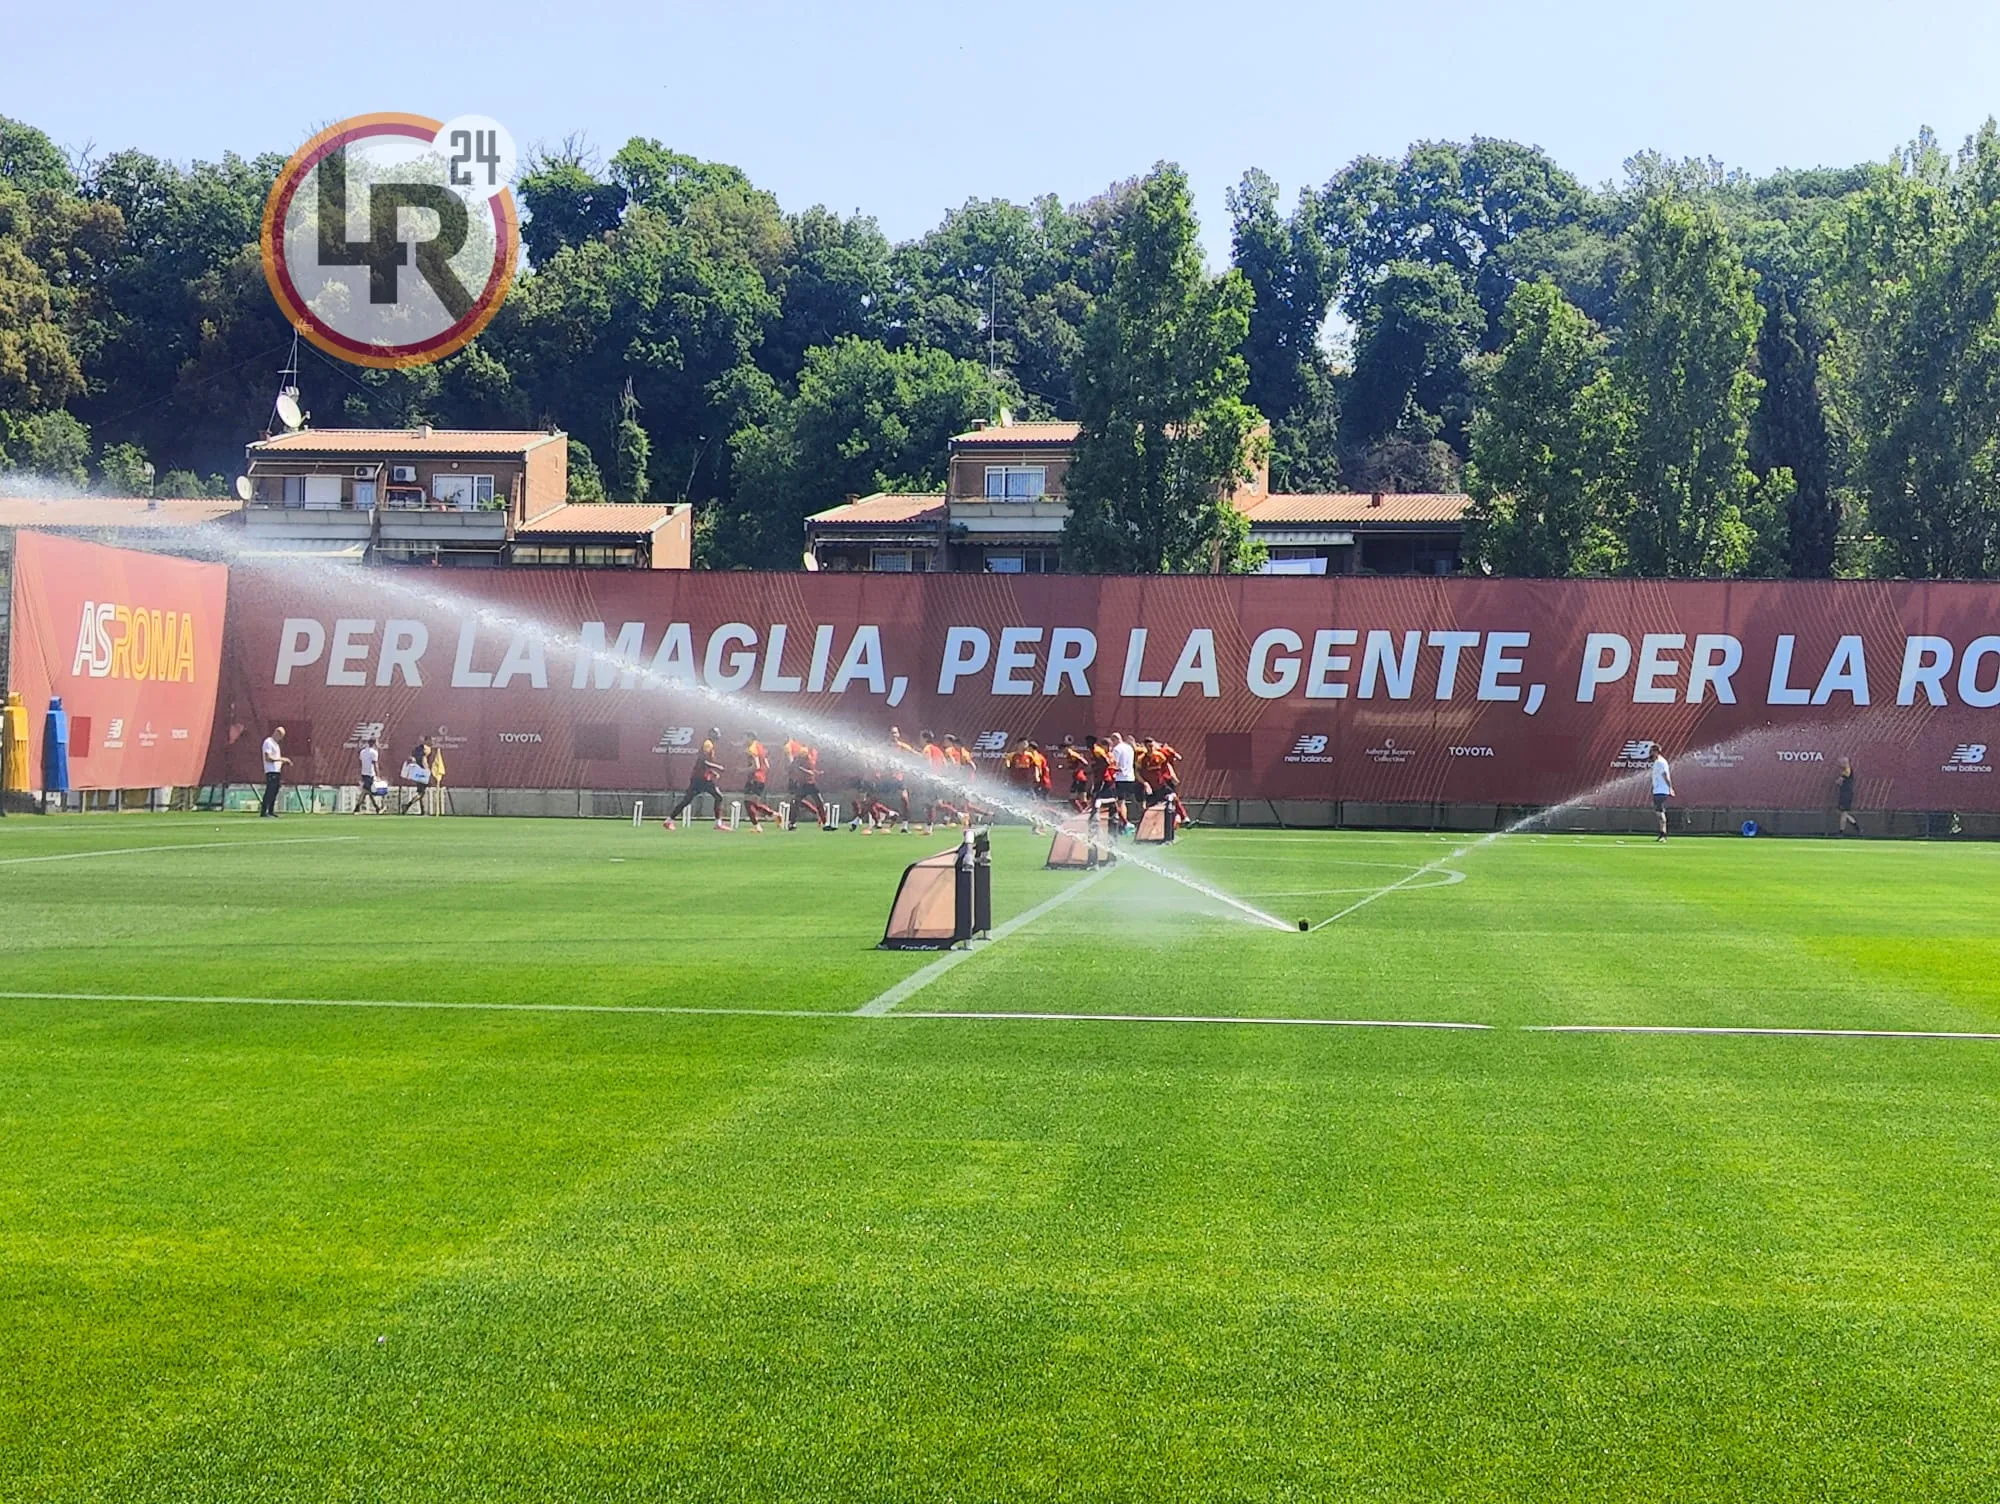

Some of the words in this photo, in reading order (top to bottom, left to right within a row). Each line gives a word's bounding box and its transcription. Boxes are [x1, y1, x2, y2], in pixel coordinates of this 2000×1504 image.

[274, 618, 429, 687] PER
[451, 620, 549, 688] LA
[571, 621, 909, 707] MAGLIA,
[937, 626, 1098, 696] PER
[1120, 628, 1220, 697] LA
[1246, 628, 1546, 716] GENTE,
[1576, 633, 1743, 704] PER
[1766, 635, 1870, 705] LA
[499, 733, 542, 742] TOYOTA
[668, 746, 699, 754] balance
[1449, 747, 1494, 757] TOYOTA
[1301, 755, 1333, 763] balance
[1777, 752, 1824, 762] TOYOTA
[1959, 764, 1992, 773] balance
